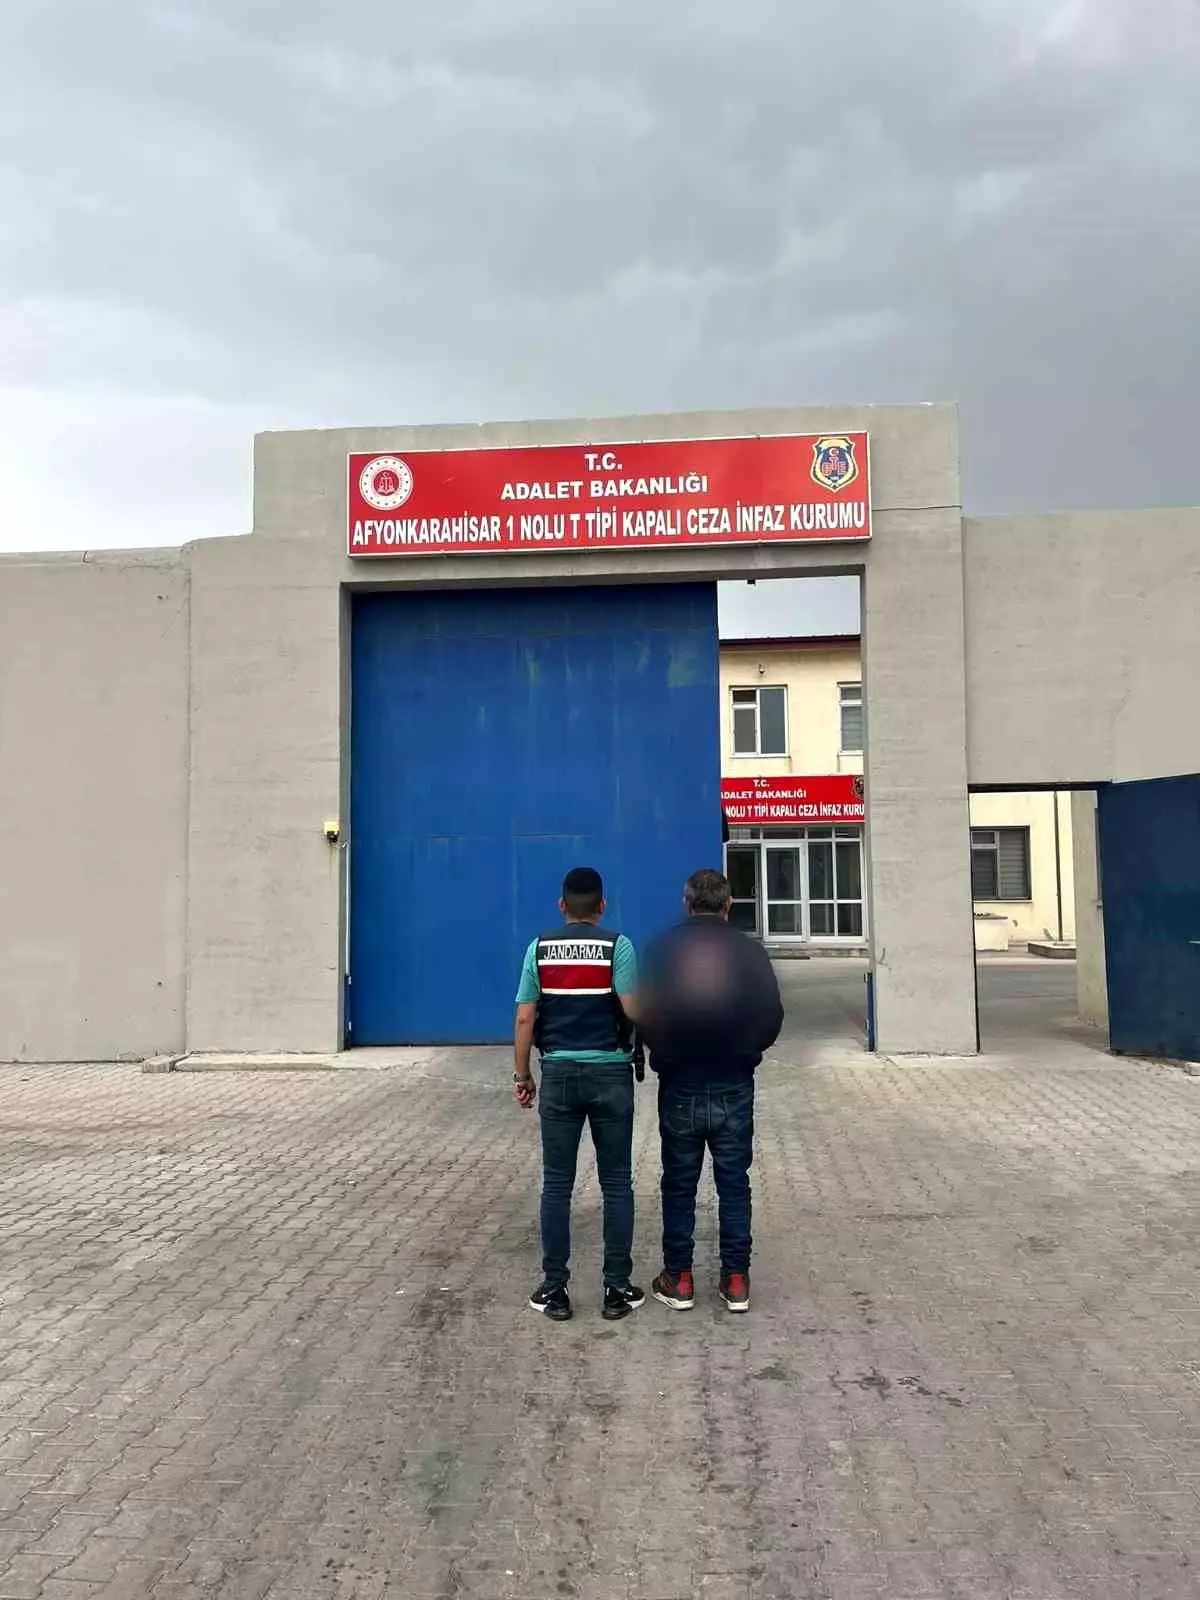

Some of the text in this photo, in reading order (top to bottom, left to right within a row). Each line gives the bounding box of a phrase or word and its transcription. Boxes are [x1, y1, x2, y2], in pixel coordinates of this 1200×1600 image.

[584, 453, 623, 471] T.C.
[501, 472, 708, 500] ADALET BAKANLIĞI
[352, 501, 865, 546] AFYONKARAHİSAR 1 NOLU T TİPİ KAPALI CEZA İNFAZ KURUMU
[753, 779, 770, 788] T.C.
[770, 804, 797, 817] KAPALI
[798, 804, 818, 817] CEZA
[843, 803, 864, 816] KURU
[544, 945, 604, 960] JANDARMA
